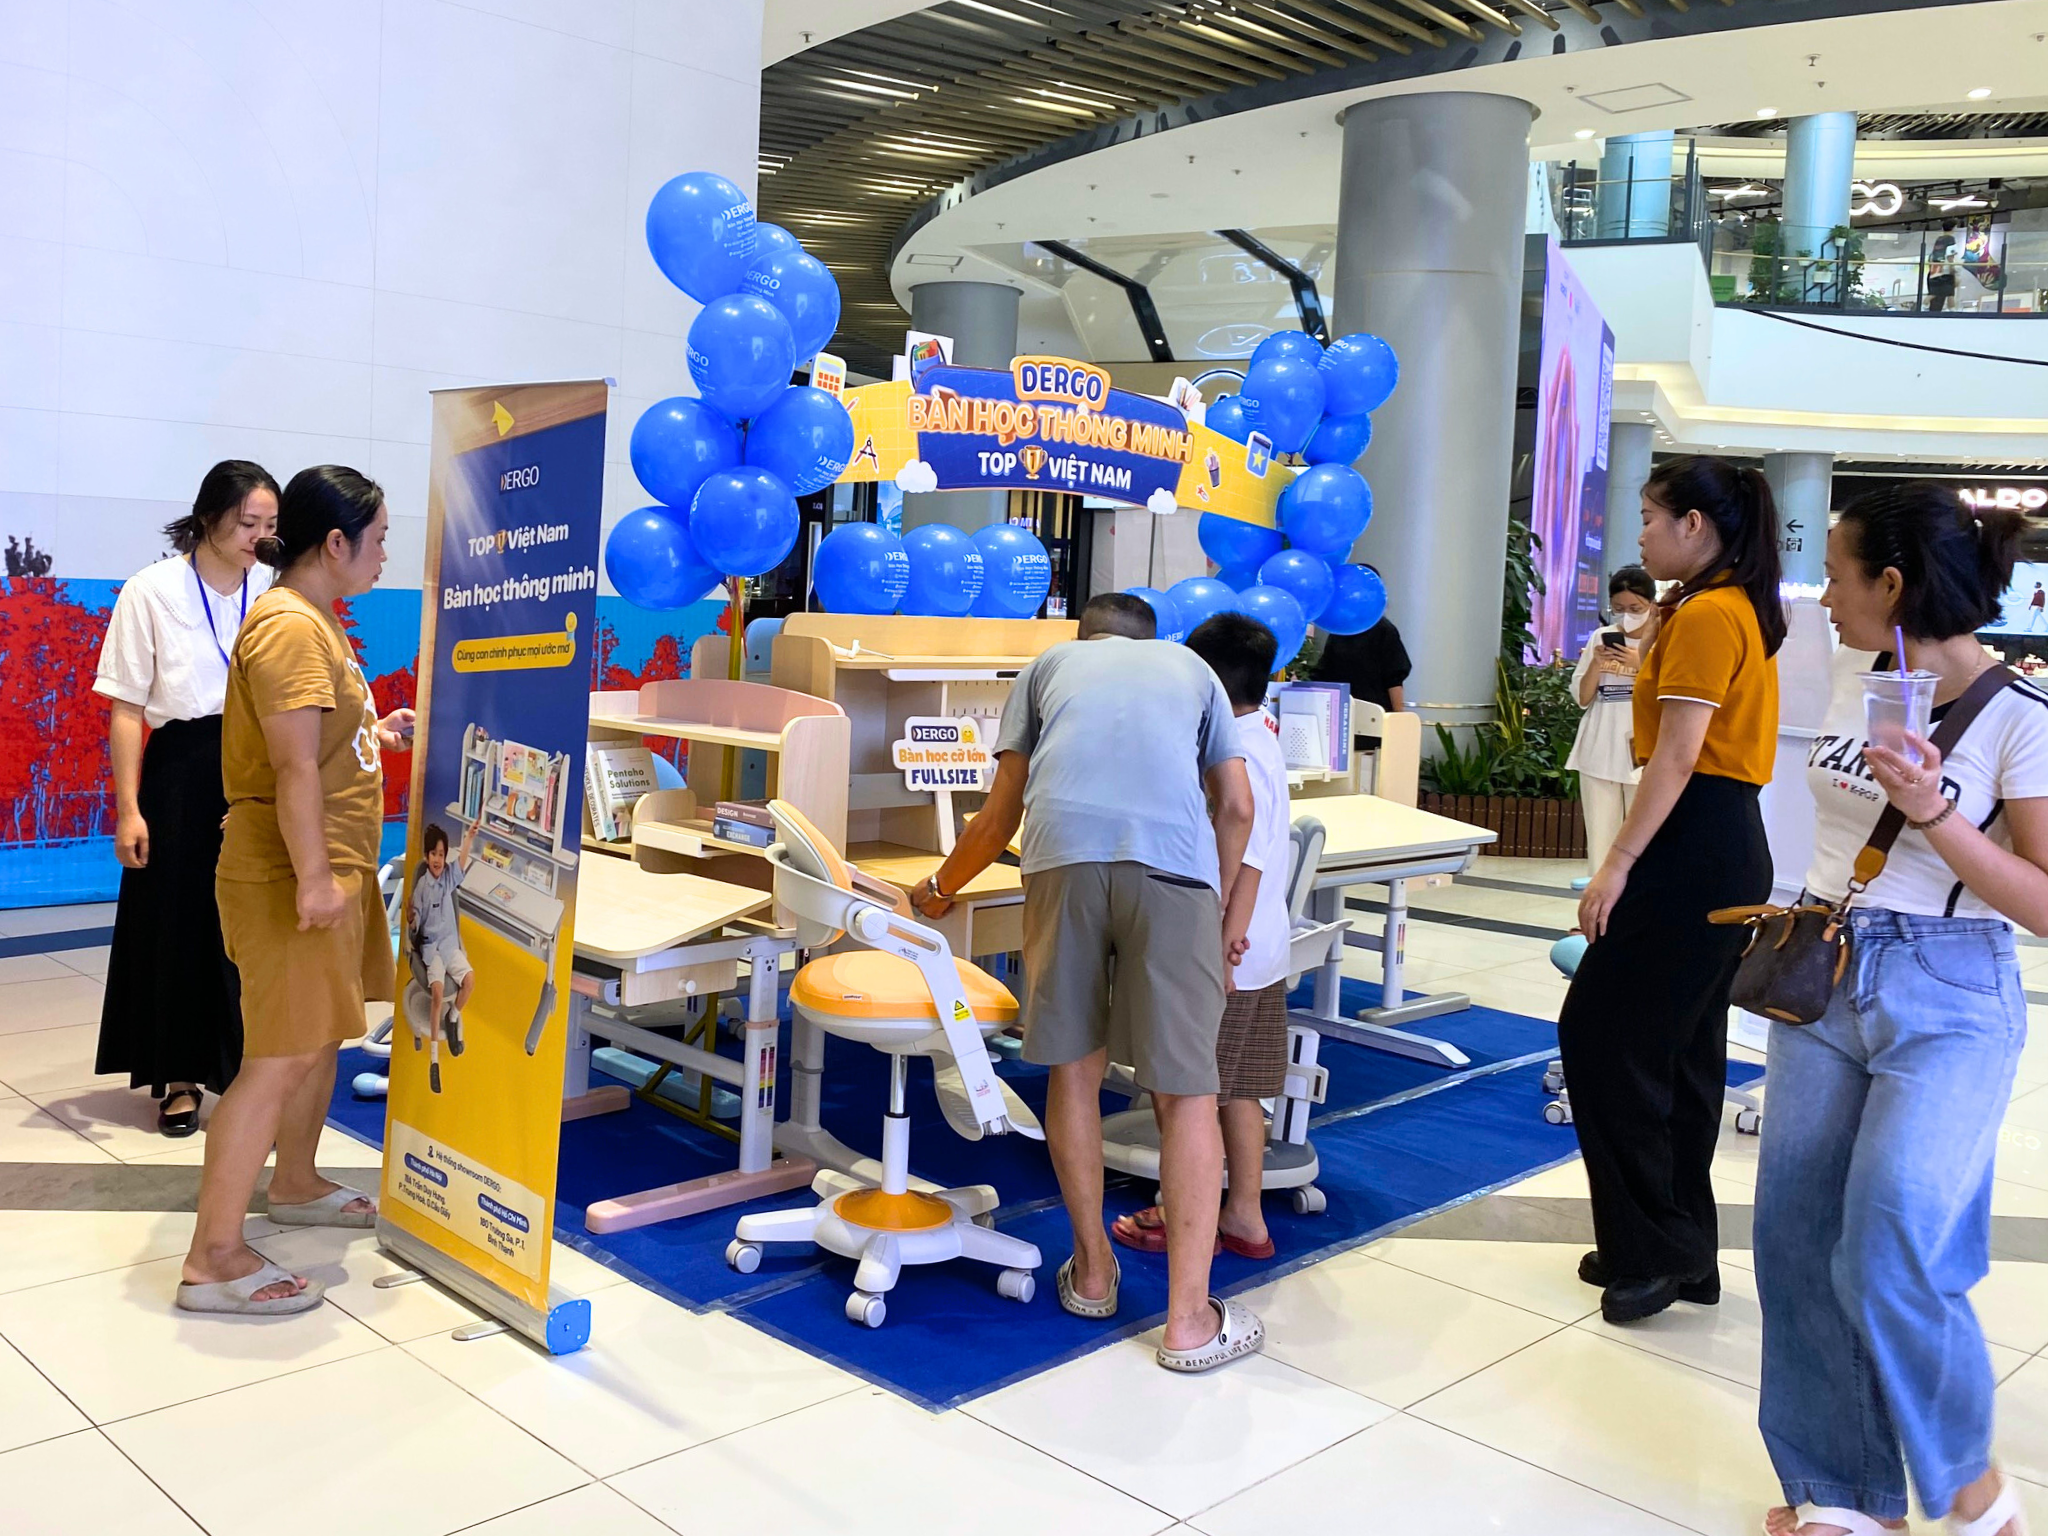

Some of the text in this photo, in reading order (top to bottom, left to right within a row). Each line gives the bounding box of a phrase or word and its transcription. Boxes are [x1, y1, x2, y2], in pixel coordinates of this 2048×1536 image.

[1021, 364, 1102, 402] DERGO
[909, 388, 1194, 463] BÀN HỌC THÔNG MINH
[978, 451, 1017, 476] TOP
[1049, 454, 1089, 488] VIỆT
[1090, 463, 1132, 490] NAM
[1959, 488, 2048, 509] ALDO
[468, 537, 494, 557] TOP
[508, 527, 535, 553] Việt
[538, 523, 569, 544] Nam
[444, 565, 595, 611] Bàn học thông minh
[912, 727, 957, 740] DERGO
[898, 747, 923, 763] Bàn
[925, 749, 948, 767] học
[967, 747, 987, 763] lớn
[607, 768, 645, 778] Pentaho
[911, 768, 978, 785] FULLSIZE
[609, 778, 650, 789] Solutions
[717, 807, 739, 818] DESIGN
[1185, 1352, 1228, 1367] BEAUTIFUL
